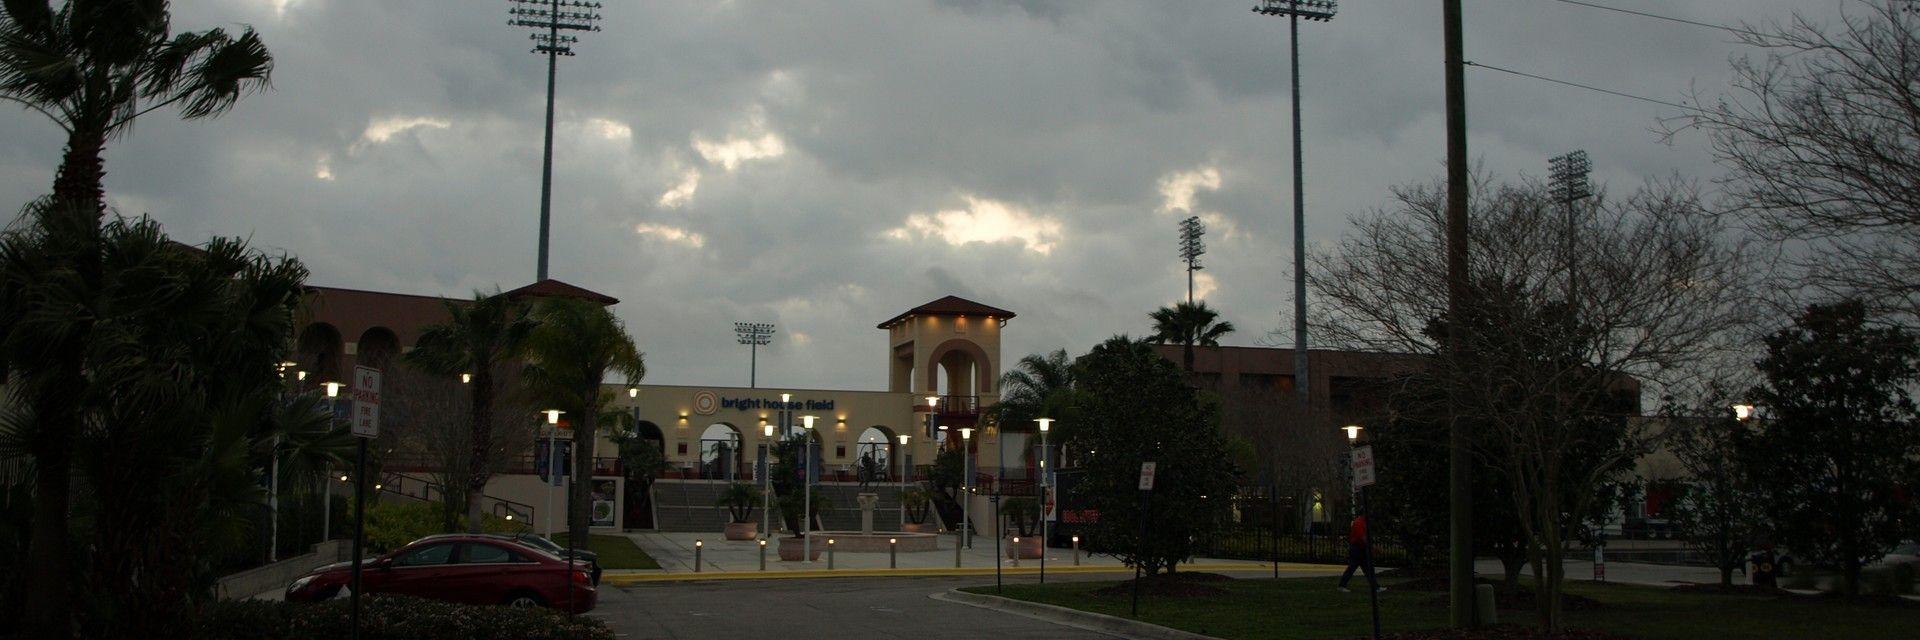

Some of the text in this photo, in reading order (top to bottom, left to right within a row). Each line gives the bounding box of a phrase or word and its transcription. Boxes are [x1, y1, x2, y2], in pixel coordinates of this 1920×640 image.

[362, 375, 374, 389] NO
[721, 397, 834, 411] bright house field
